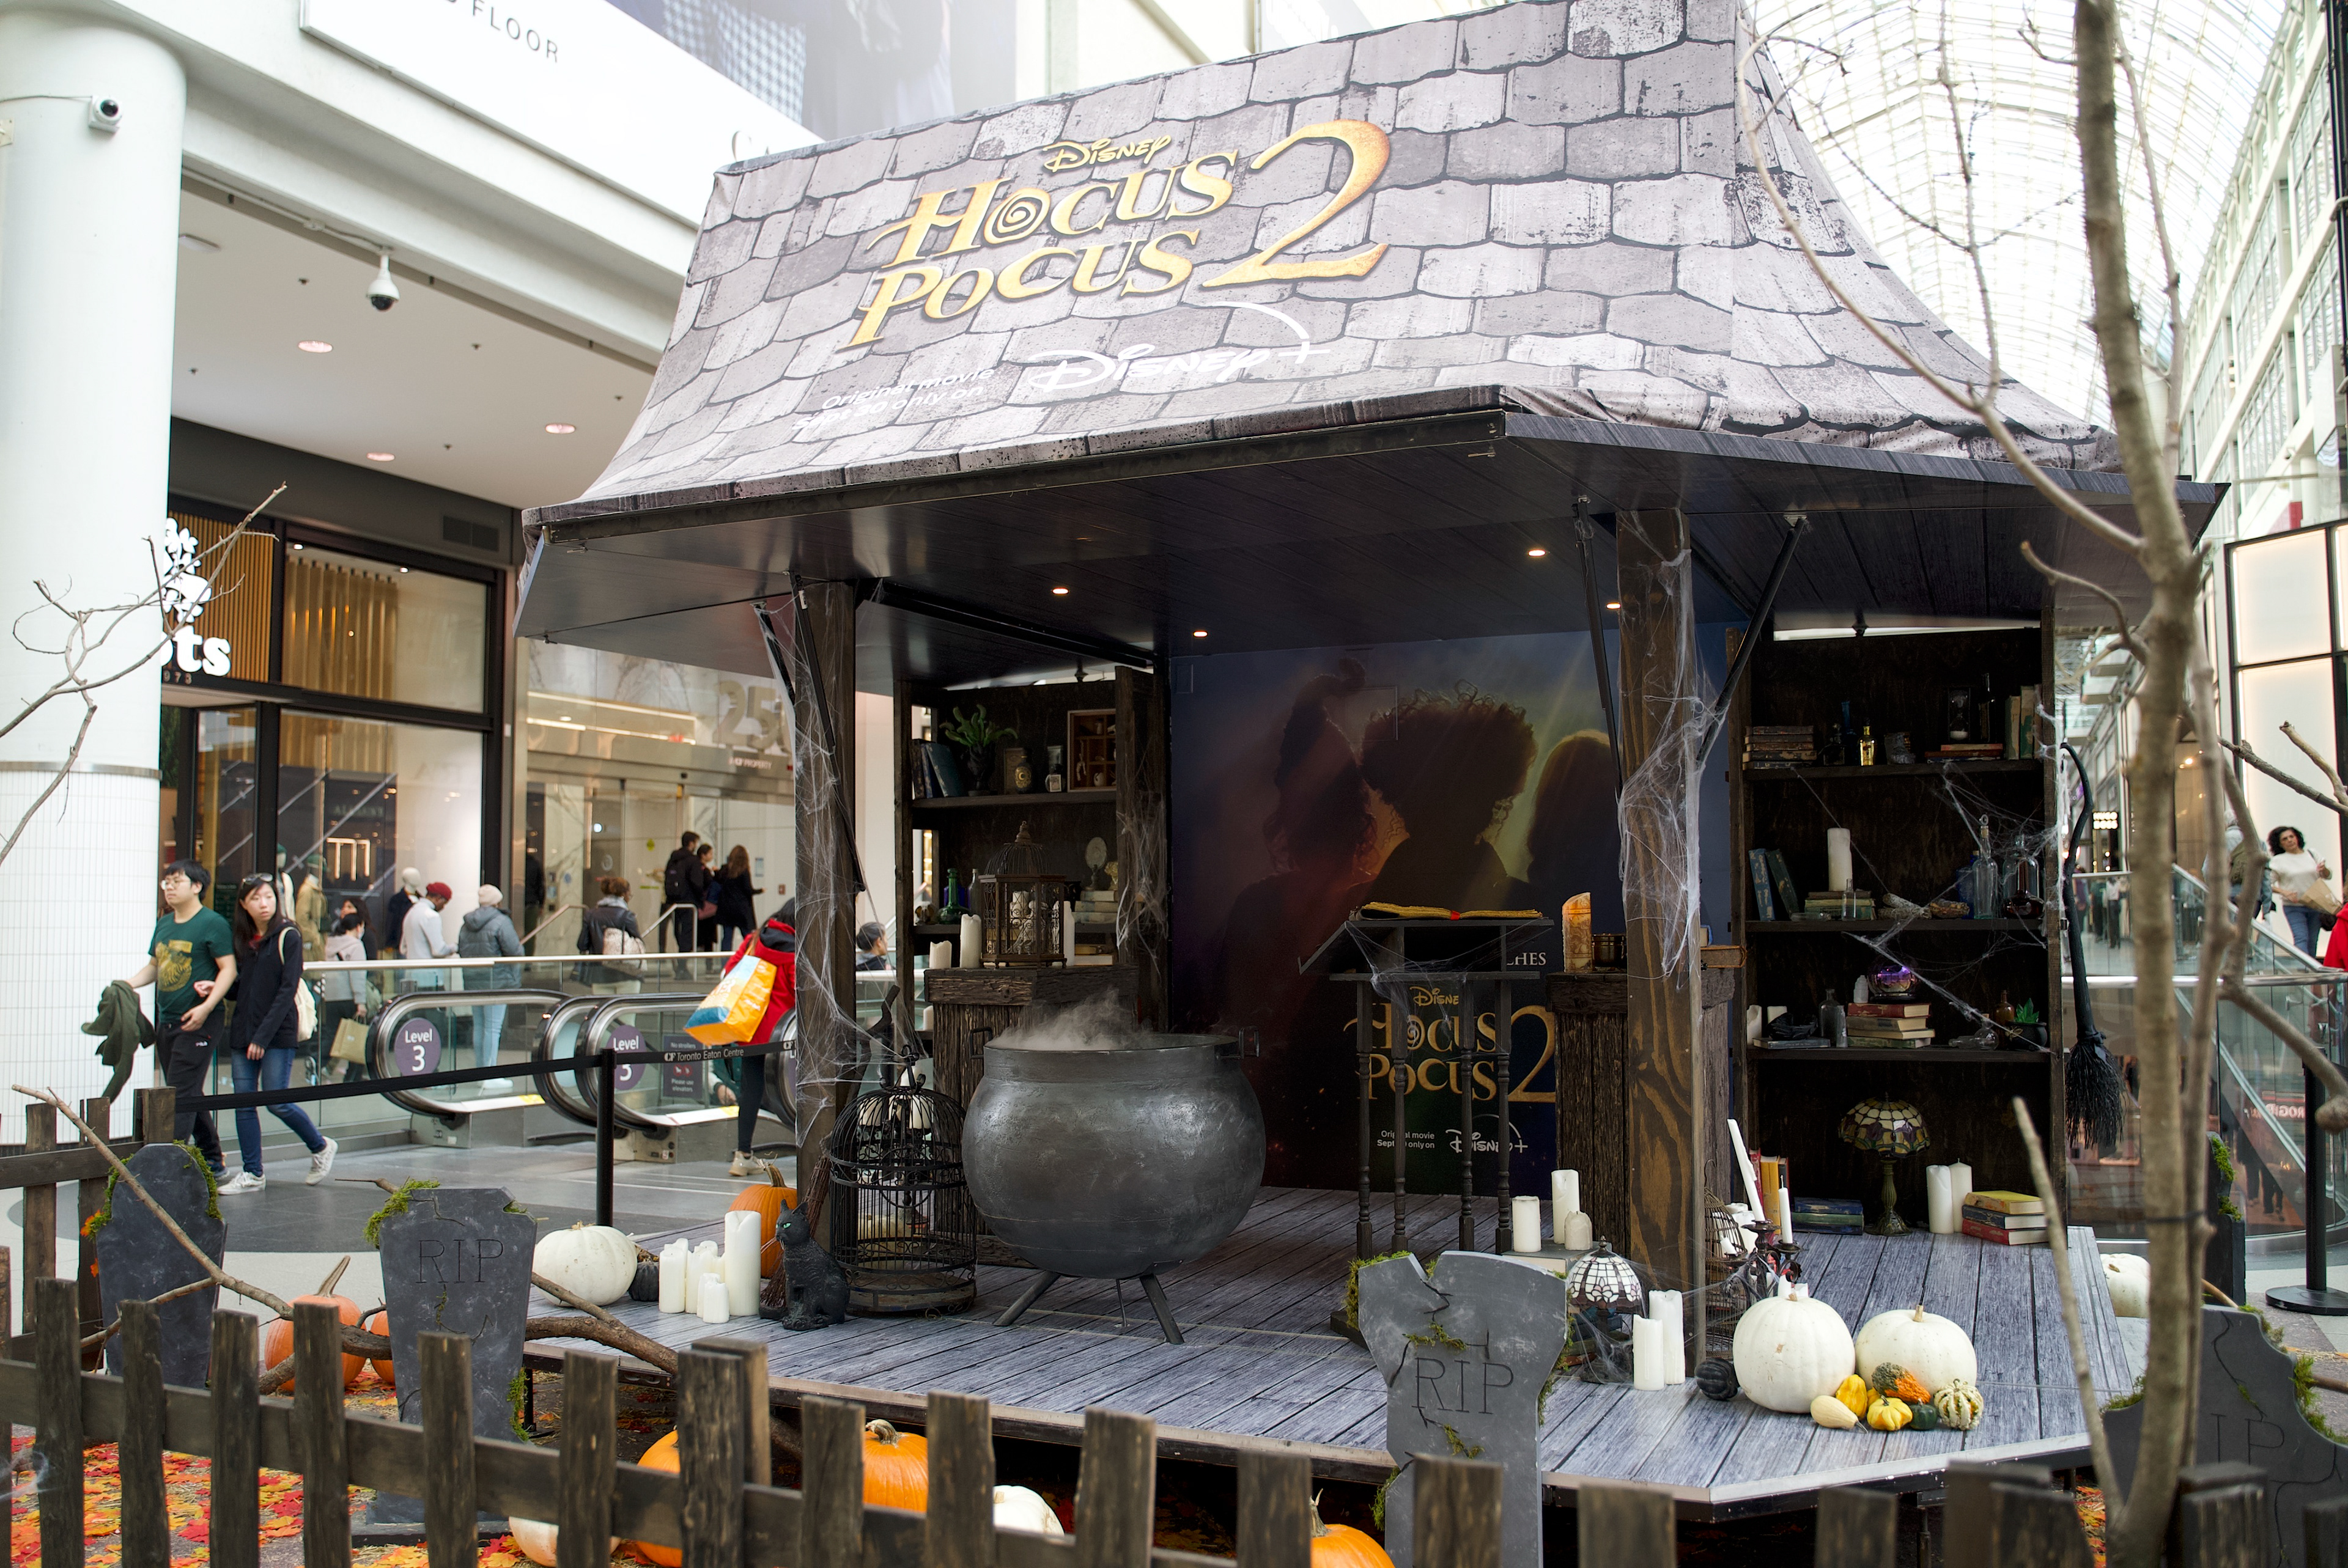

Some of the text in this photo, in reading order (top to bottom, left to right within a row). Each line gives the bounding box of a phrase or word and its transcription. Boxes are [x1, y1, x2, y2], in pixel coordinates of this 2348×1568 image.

[471, 0, 558, 62] FLOOR
[1042, 134, 1172, 173] Disney
[866, 150, 1238, 269] HOCUS
[1202, 119, 1390, 287] 2
[836, 228, 1202, 350] POCUS
[792, 386, 986, 430] Sept 30 only on
[822, 368, 995, 410] Original movie
[1409, 985, 1460, 1007] Disne
[405, 1028, 432, 1043] Level
[613, 1036, 639, 1051] Level
[676, 1052, 701, 1061] Toronto
[703, 1050, 722, 1059] Eaton
[723, 1048, 744, 1058] Centre
[1508, 1004, 1556, 1103] 2
[412, 1045, 426, 1072] 3
[416, 1239, 504, 1283] RIP
[1411, 1357, 1514, 1415] RIP
[2210, 1413, 2285, 1465] IP
